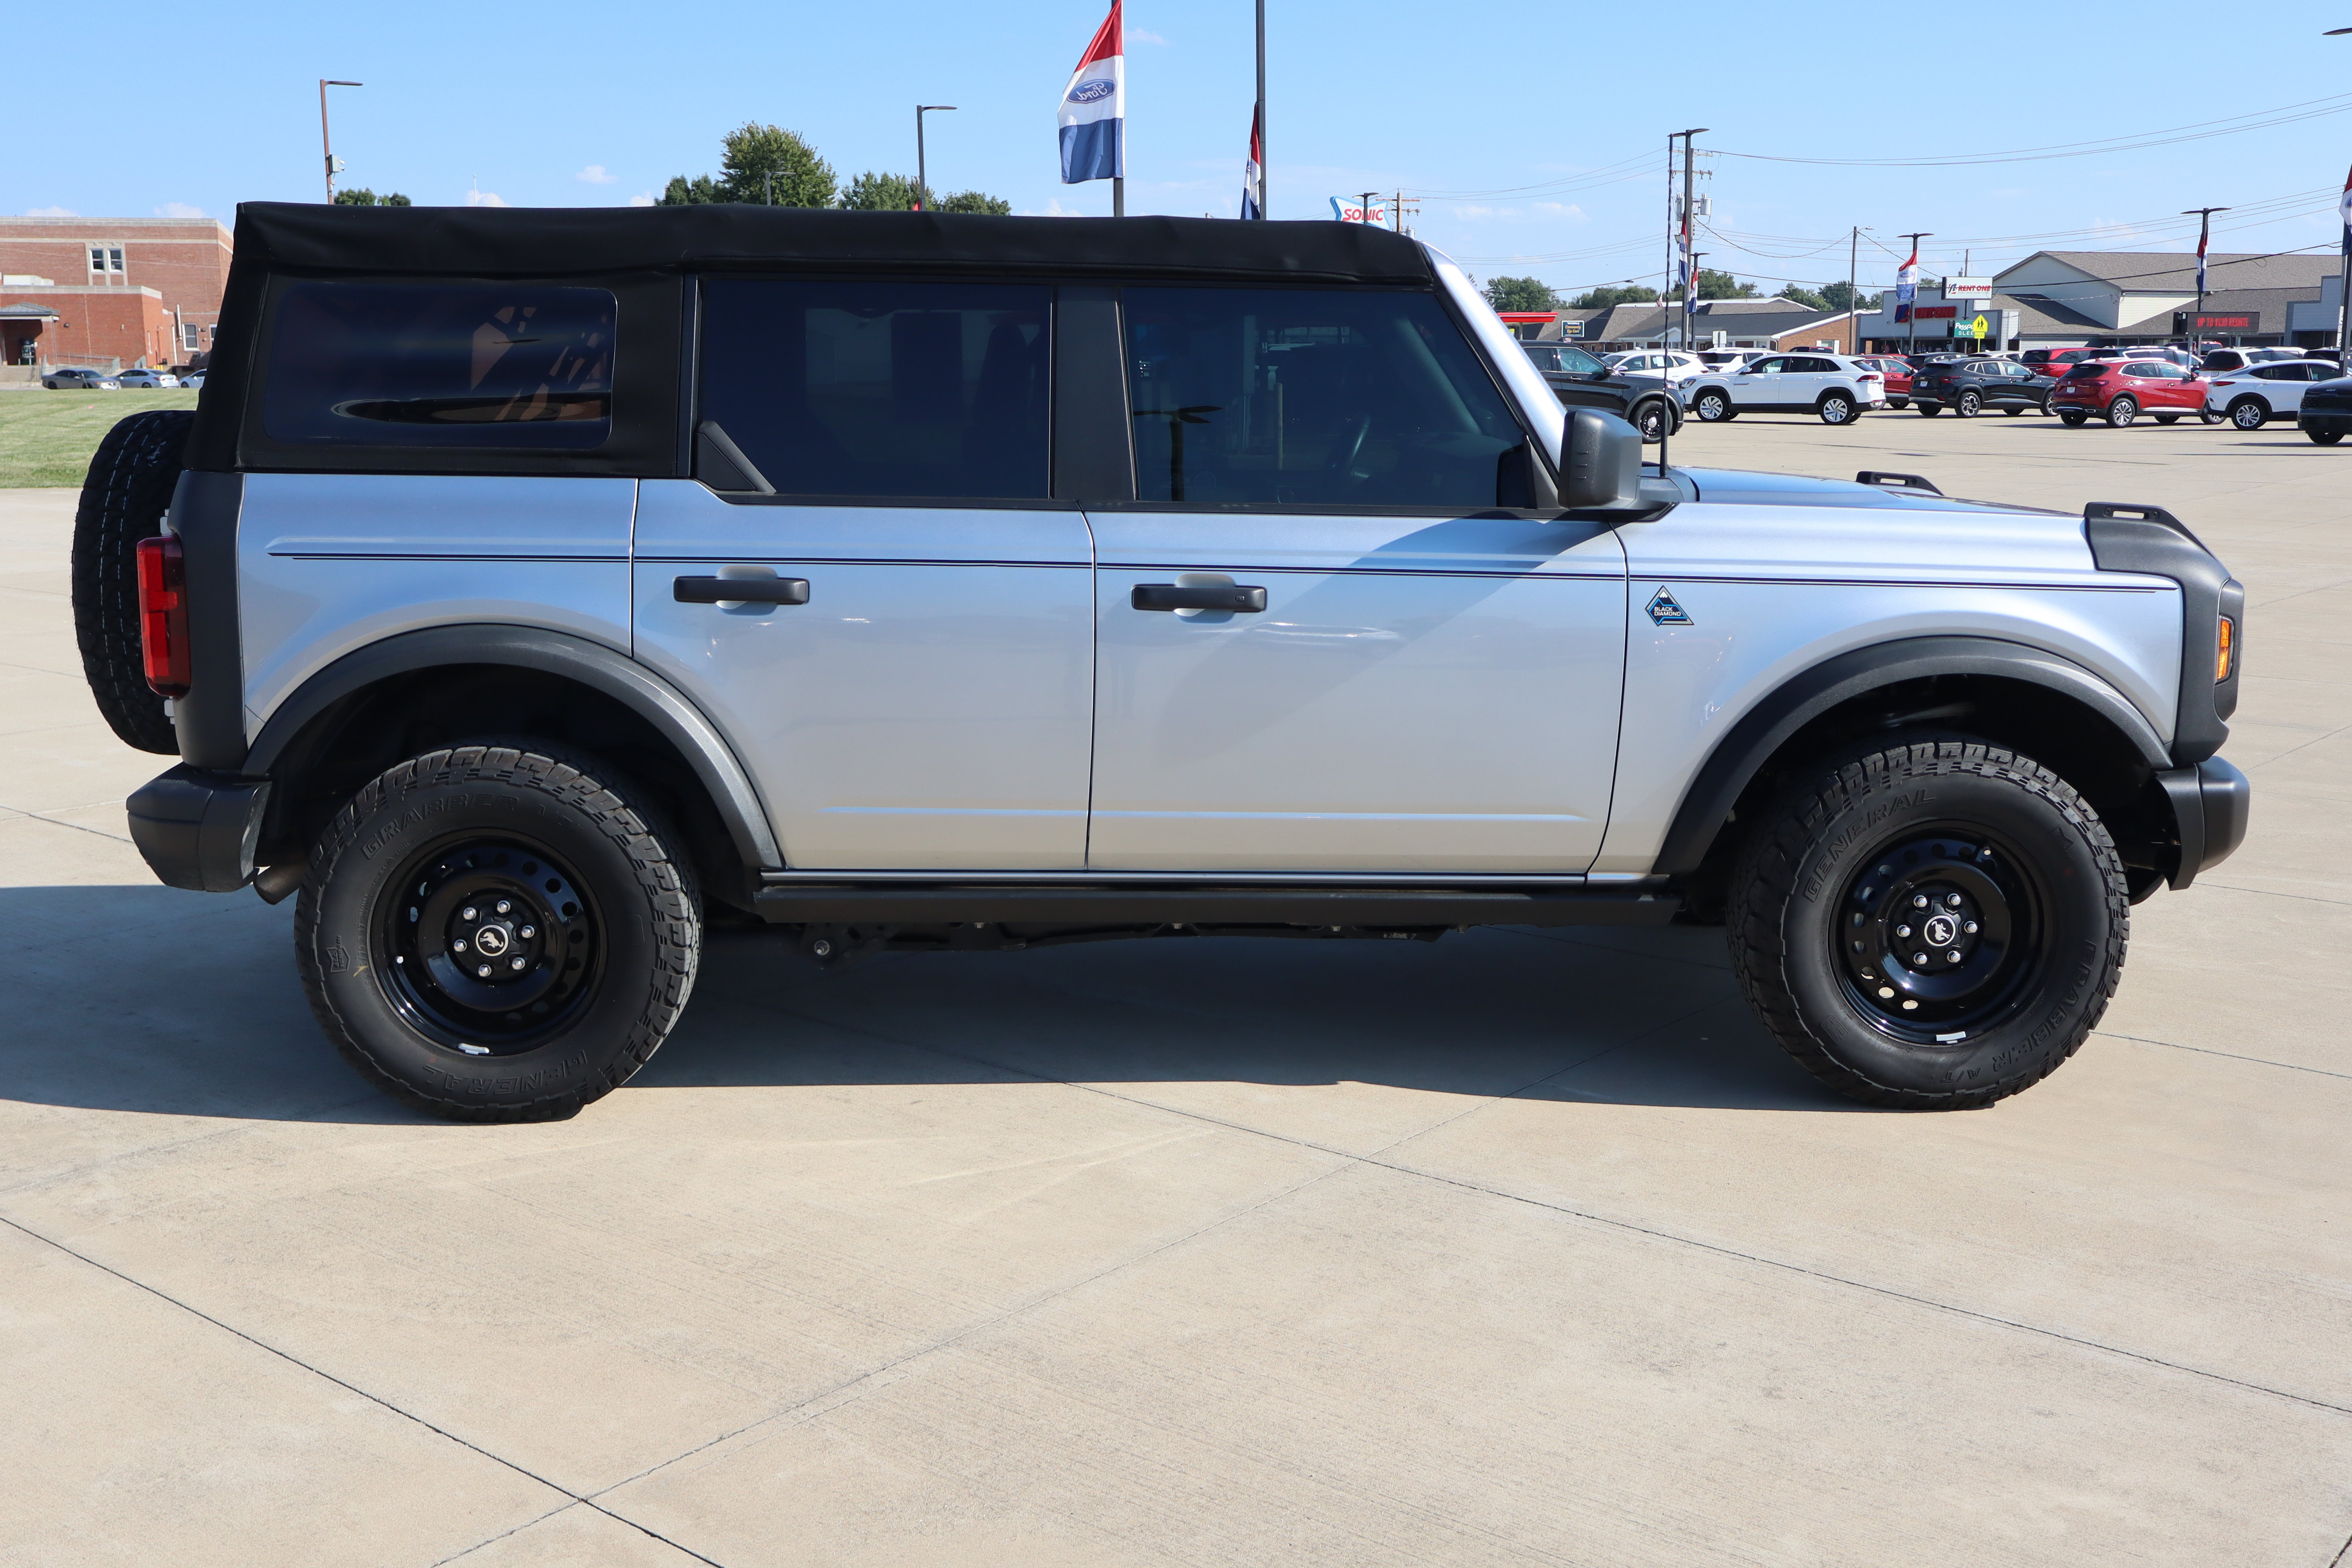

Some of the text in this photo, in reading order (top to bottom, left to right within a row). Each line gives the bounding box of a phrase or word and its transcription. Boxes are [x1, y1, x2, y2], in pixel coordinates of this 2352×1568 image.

[1910, 307, 1935, 318] ENT
[2197, 317, 2205, 327] UP
[361, 793, 520, 860] GRABBER
[1802, 788, 1936, 903] GENERAL
[1992, 940, 2097, 1073] GRABBER
